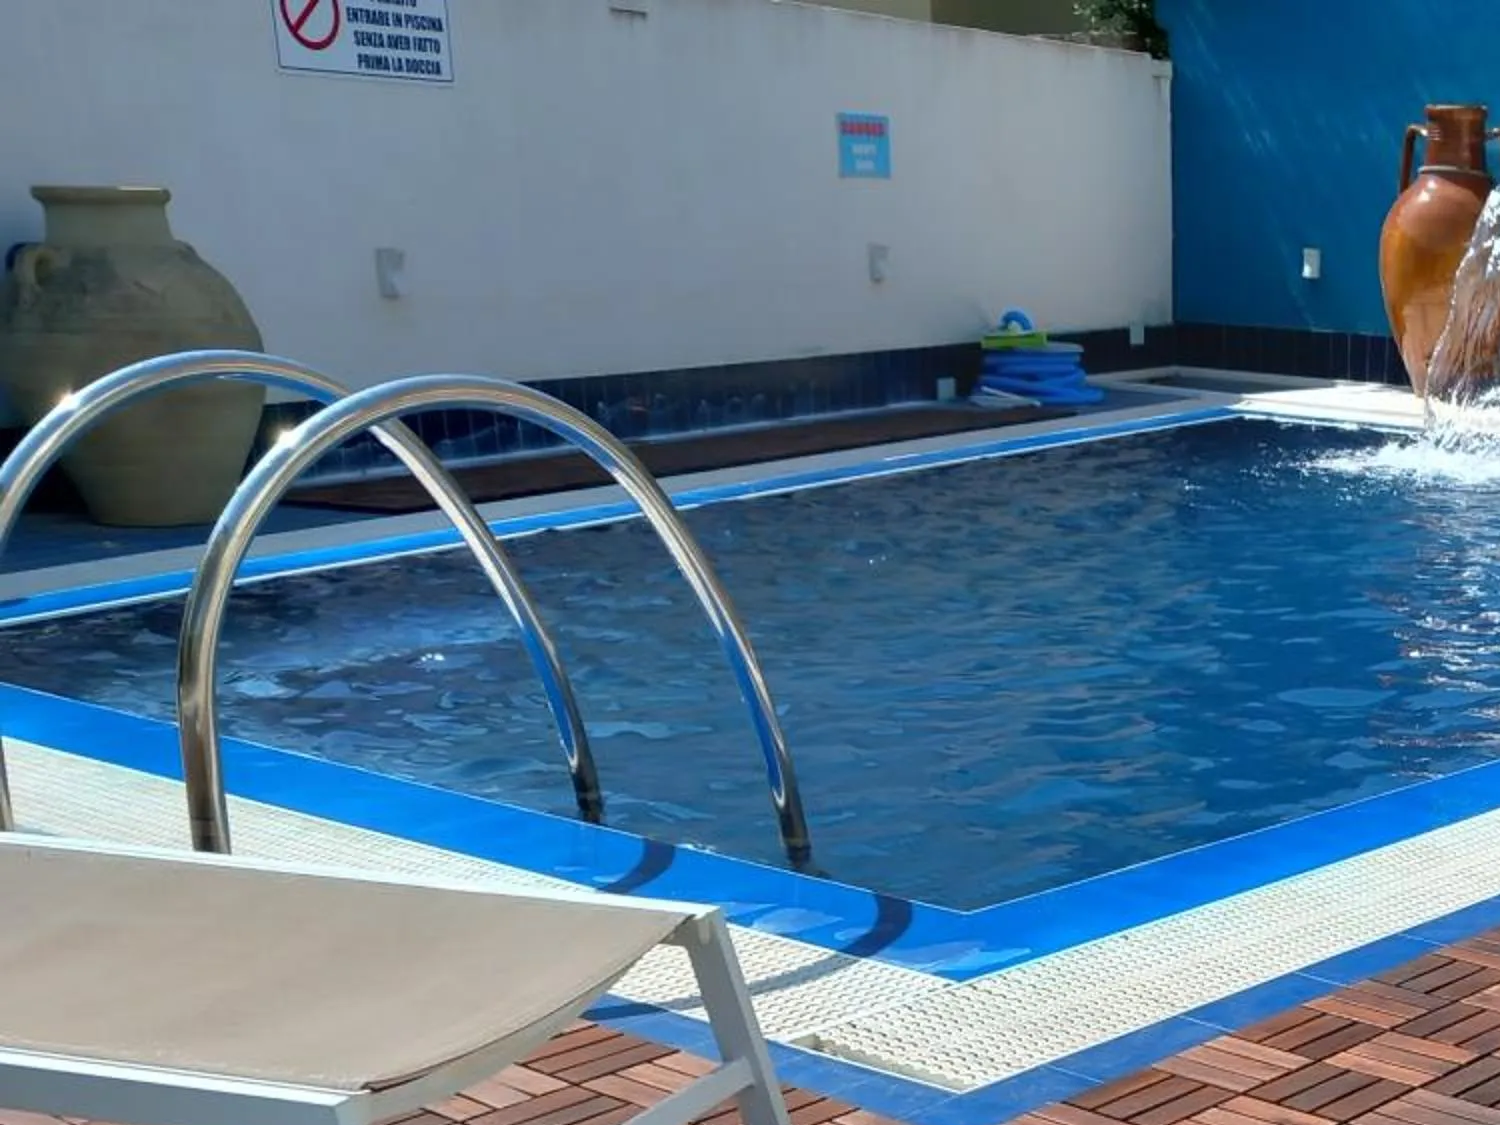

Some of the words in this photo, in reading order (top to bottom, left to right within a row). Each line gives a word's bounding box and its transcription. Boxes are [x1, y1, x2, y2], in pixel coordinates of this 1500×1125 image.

[347, 6, 390, 27] ENTRARE
[392, 12, 403, 28] IN
[404, 14, 443, 33] PISCINA
[353, 31, 384, 48] SENZA
[386, 34, 411, 51] AVER
[412, 37, 441, 54] FATTO
[357, 54, 391, 71] PRIMA
[392, 57, 403, 73] LA
[405, 59, 441, 76] DOCCIA
